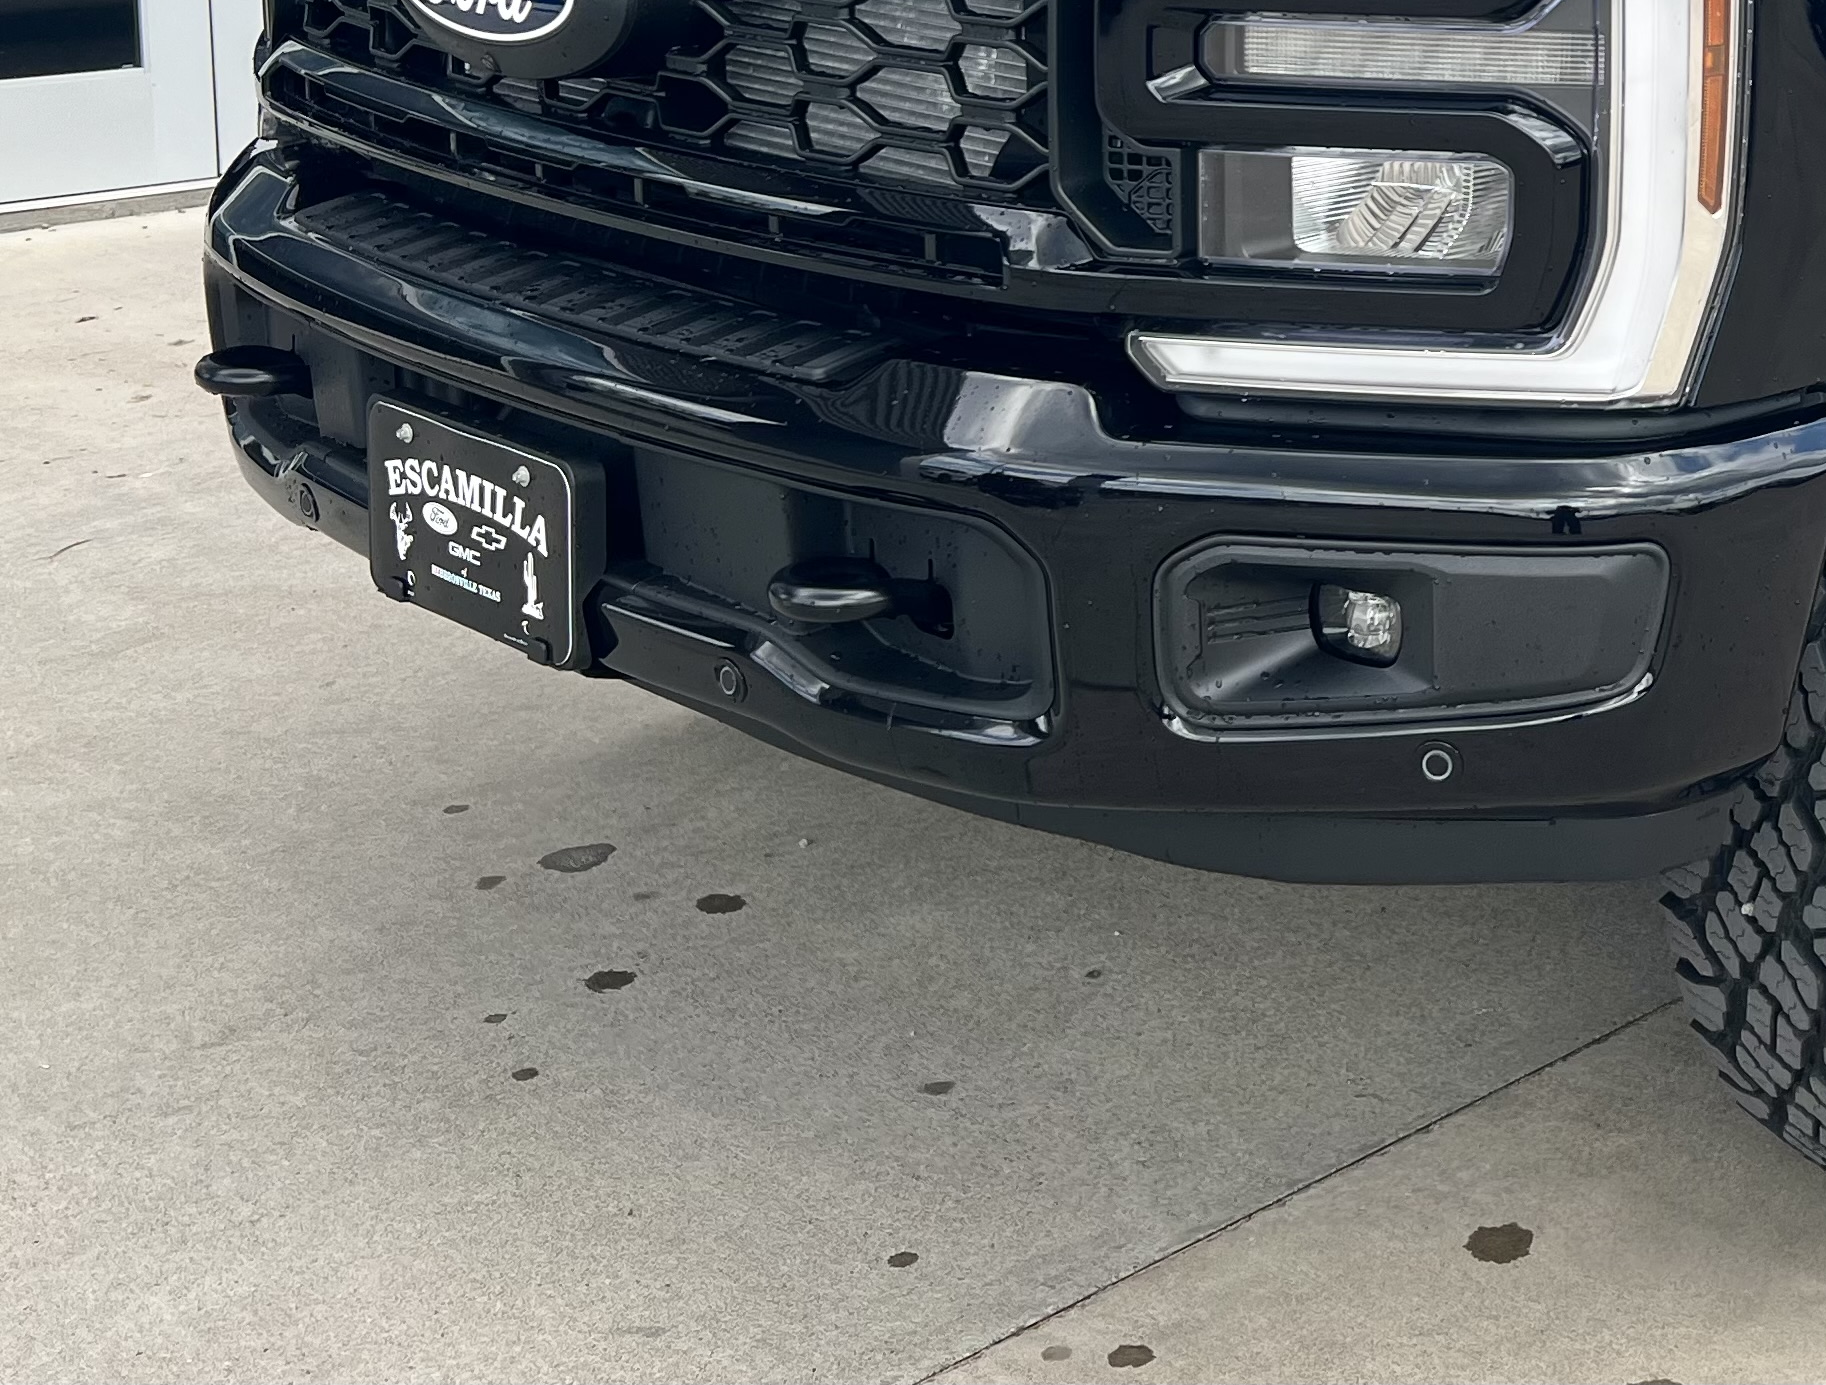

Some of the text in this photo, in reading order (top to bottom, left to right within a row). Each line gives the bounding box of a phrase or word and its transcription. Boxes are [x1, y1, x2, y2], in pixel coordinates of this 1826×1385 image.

[383, 458, 548, 558] ESCAMILLA
[448, 540, 482, 567] GMC
[477, 584, 501, 603] TEXAS
